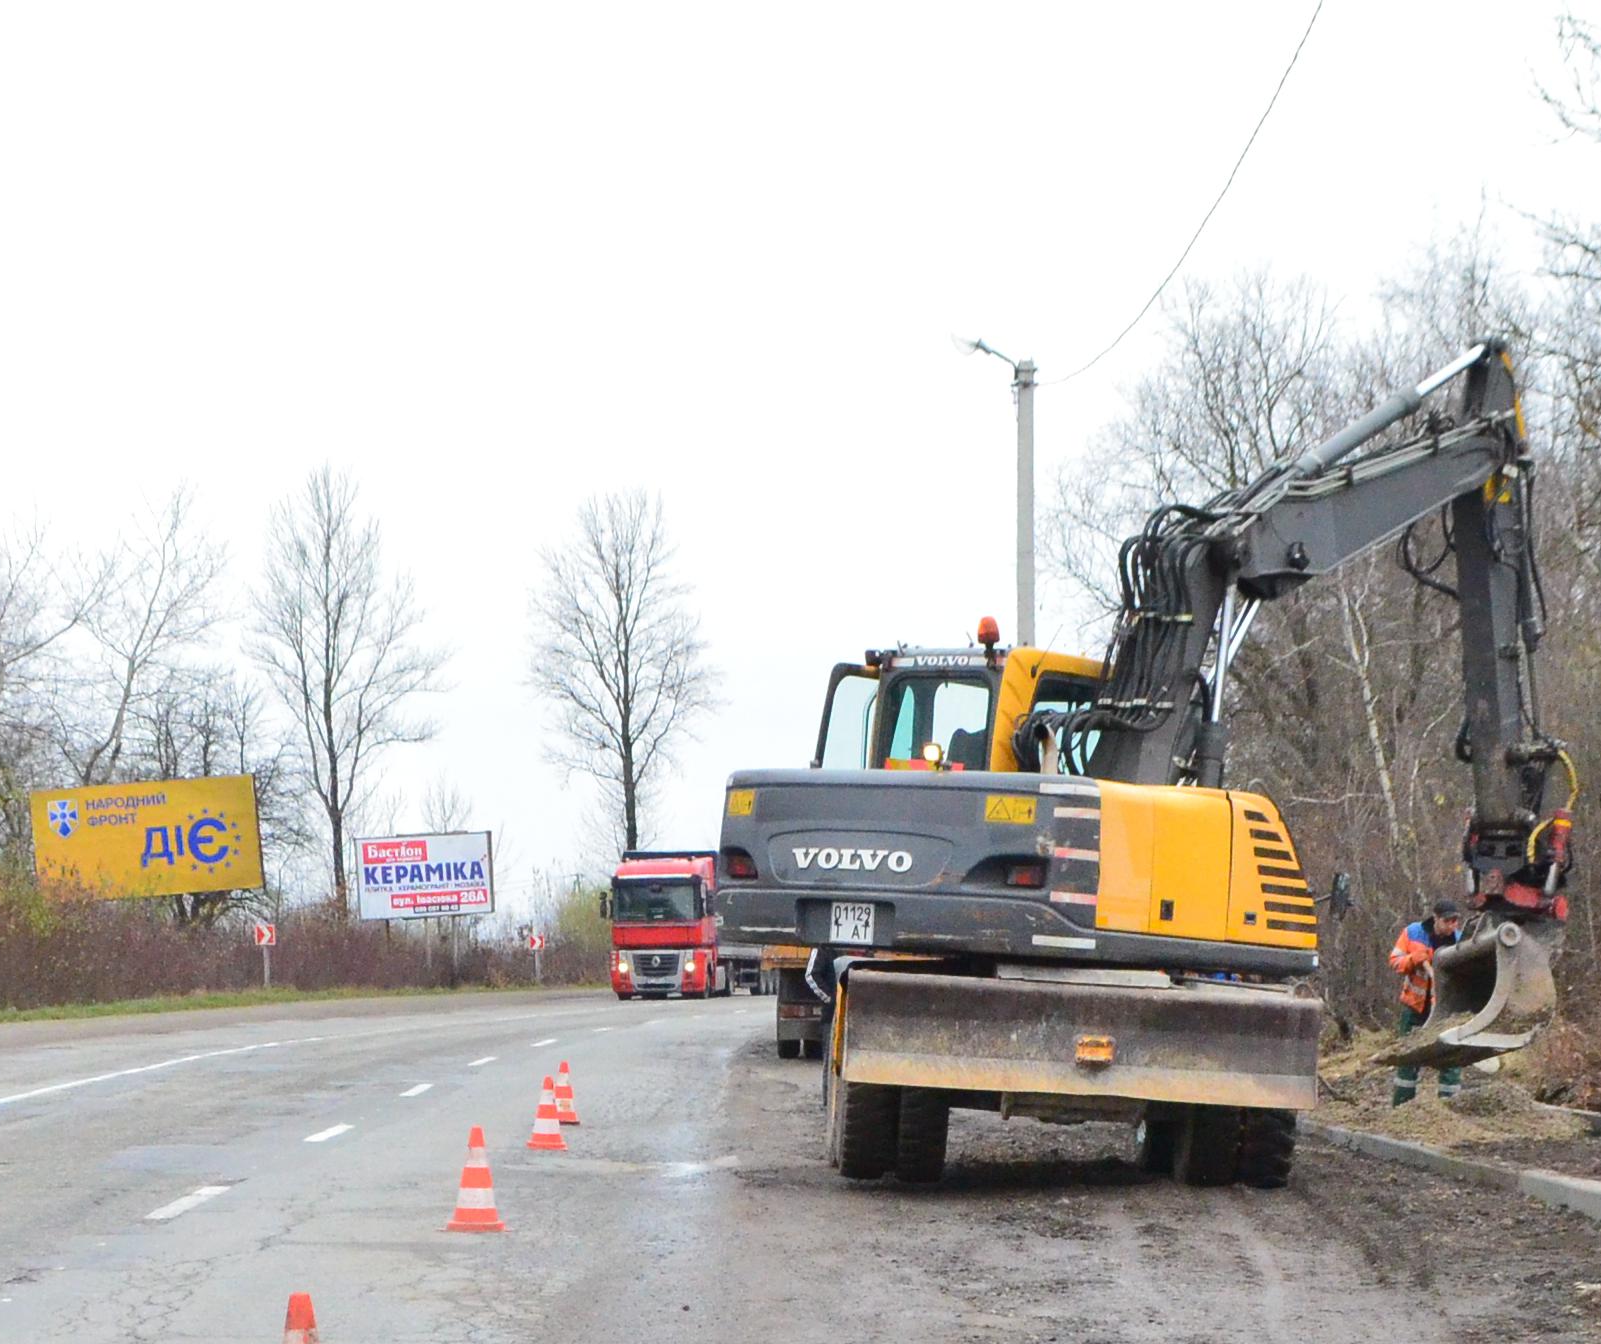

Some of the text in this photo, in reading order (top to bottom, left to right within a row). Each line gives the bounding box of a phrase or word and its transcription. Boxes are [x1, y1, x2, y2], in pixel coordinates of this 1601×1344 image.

[916, 655, 969, 667] VOLVO
[85, 791, 167, 811] НАРОДНИЙ
[86, 812, 138, 827] ФРОНТ
[140, 817, 229, 868] ДІЄ
[792, 847, 914, 873] VOLVO
[364, 860, 484, 885] КЕРАМІКА
[834, 905, 871, 921] 01129
